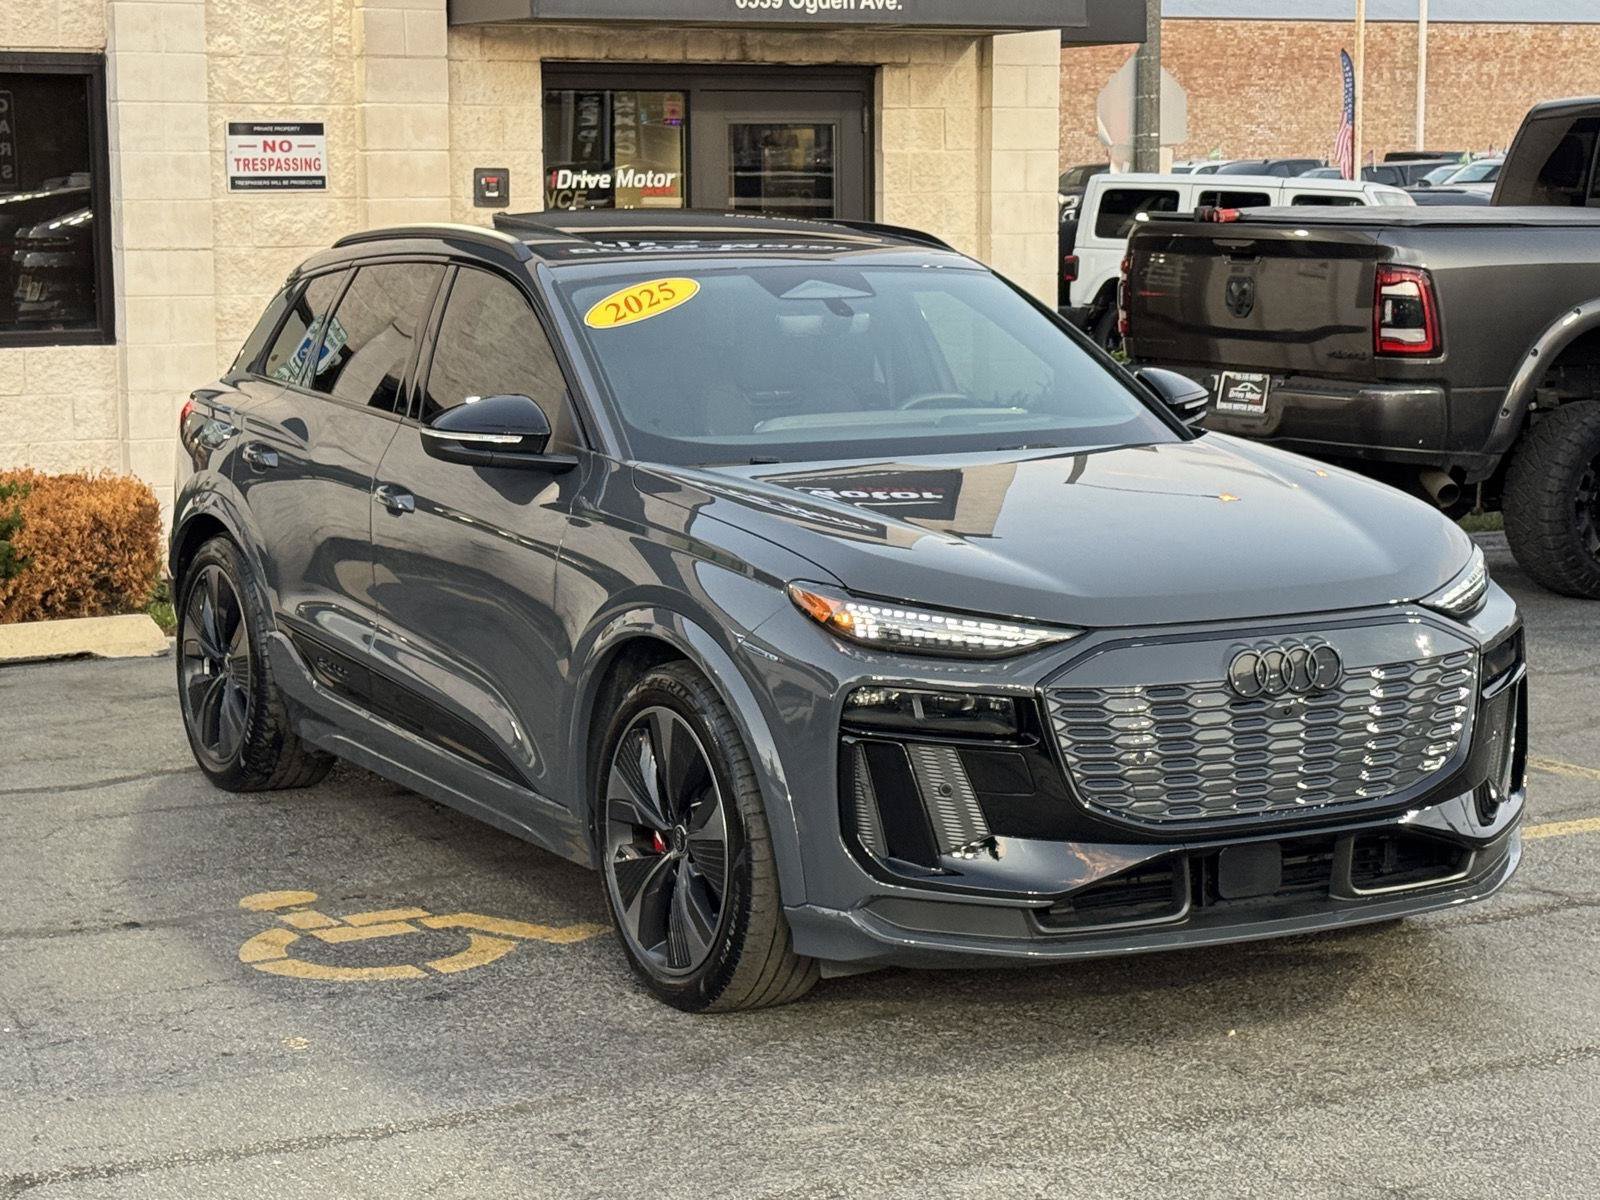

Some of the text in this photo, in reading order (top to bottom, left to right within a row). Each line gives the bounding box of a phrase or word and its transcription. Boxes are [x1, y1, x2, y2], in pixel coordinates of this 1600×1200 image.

[788, 0, 856, 14] Ogden
[859, 0, 903, 10] Ave.
[263, 140, 293, 153] NO
[234, 157, 322, 172] TRESPASSING
[615, 168, 677, 188] Motor
[605, 282, 675, 322] 2025
